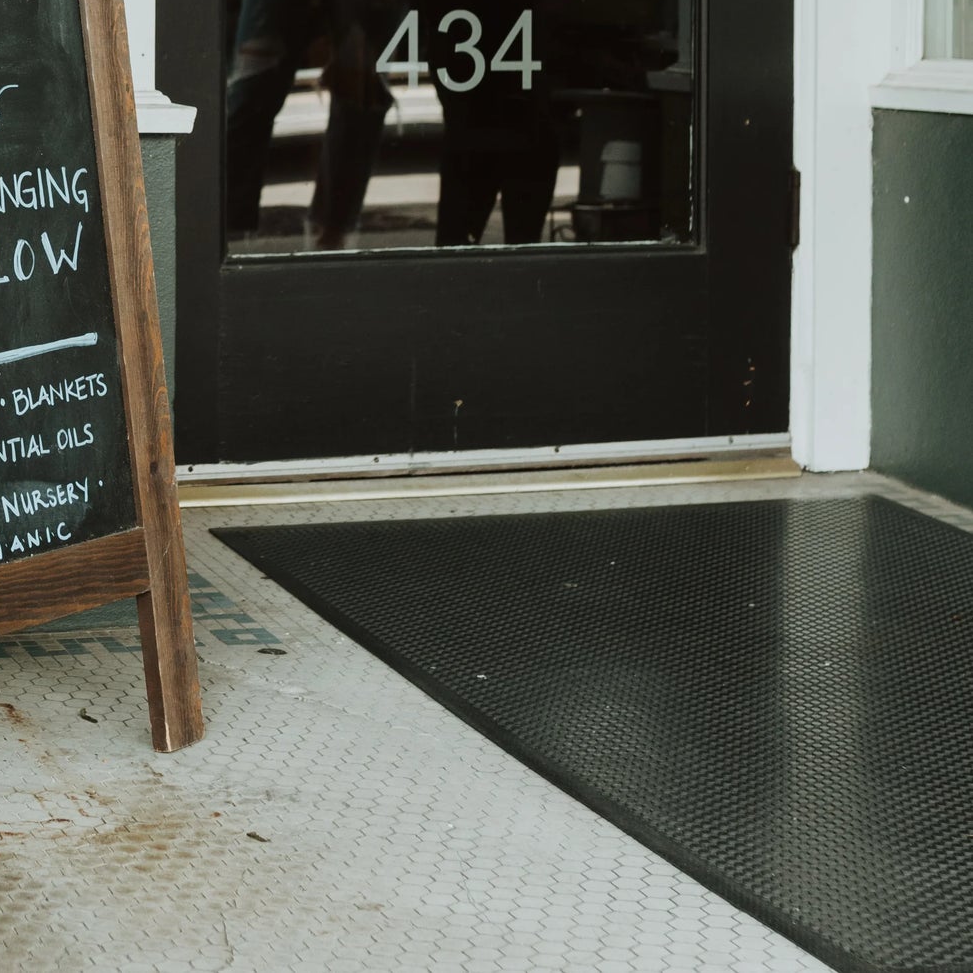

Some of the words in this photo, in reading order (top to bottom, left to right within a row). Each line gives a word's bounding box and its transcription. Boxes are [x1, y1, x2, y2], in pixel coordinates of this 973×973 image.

[375, 8, 543, 92] 434
[12, 373, 108, 416] BLANKETS
[56, 423, 95, 450] OILS
[1, 476, 90, 523] NURSERY
